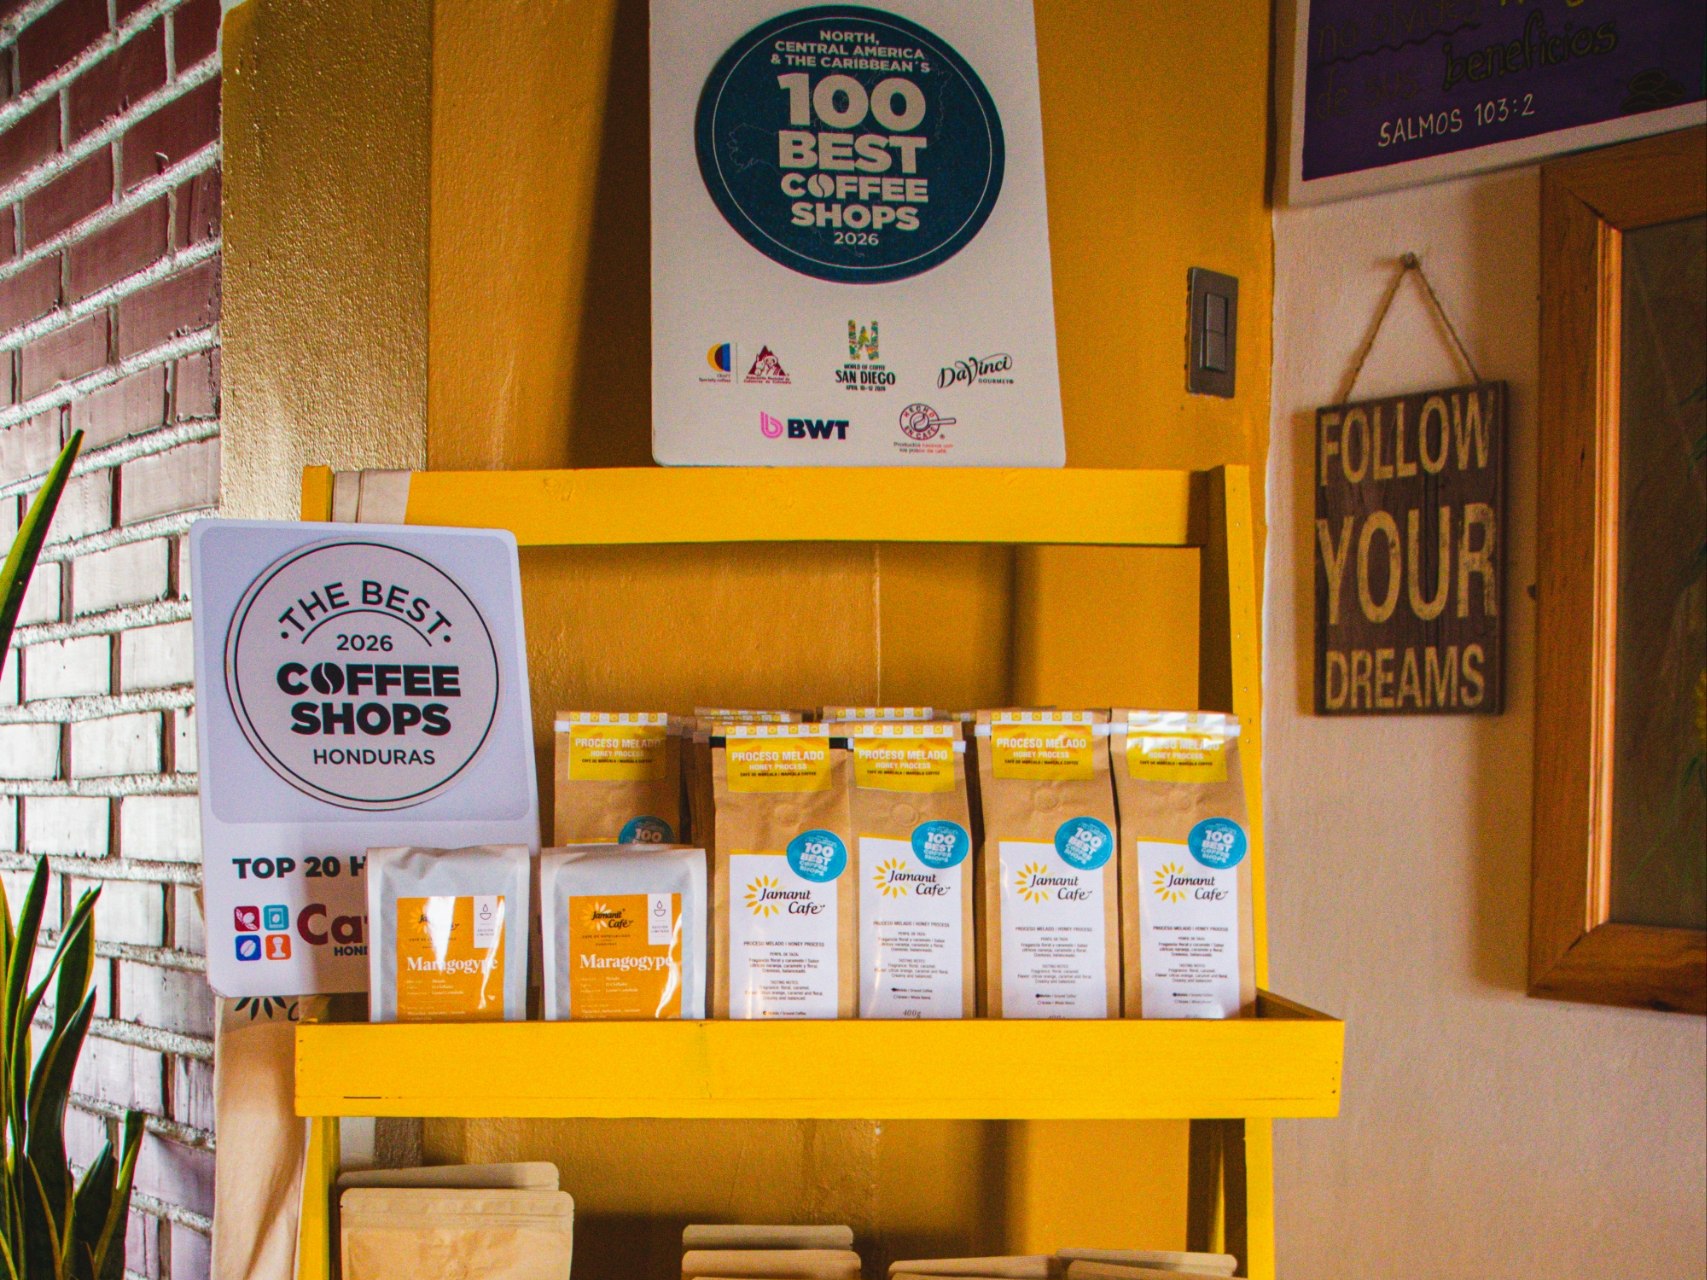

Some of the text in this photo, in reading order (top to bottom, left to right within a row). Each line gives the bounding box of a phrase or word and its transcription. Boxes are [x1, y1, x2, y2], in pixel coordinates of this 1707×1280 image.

[819, 30, 880, 46] NORTH,
[774, 40, 925, 60] CENTRAL AMERICA
[1442, 10, 1618, 90] beneficios
[770, 54, 781, 65] &
[784, 55, 817, 68] THE
[776, 72, 927, 132] 100
[1377, 93, 1535, 147] SALMOS 103:2
[778, 130, 928, 173] BEST
[780, 172, 929, 203] COFFEE
[790, 202, 920, 231] SHOPS
[833, 231, 879, 246] 2026
[835, 369, 896, 386] SAN DIEGO
[937, 353, 1013, 389] DaVinci
[787, 419, 849, 440] BWT
[1320, 390, 1494, 486] FOLLOW
[1316, 503, 1497, 625] YOUR
[336, 634, 393, 651] 2026
[276, 662, 461, 697] COFFEE
[1325, 643, 1486, 710] DREAMS
[290, 701, 452, 736] SHOPS
[575, 738, 619, 748] PROCESO
[996, 738, 1087, 748] PROCESO MELADO
[313, 749, 436, 765] HONDURAS
[732, 751, 825, 762] PROCESO MELADO
[858, 750, 948, 760] PROCESO MELADO
[635, 828, 662, 843] 100
[928, 832, 956, 845] 100
[1075, 827, 1102, 848] 100
[1205, 830, 1234, 845] 100
[805, 842, 834, 858] 100
[924, 842, 954, 852] BEST
[1068, 836, 1096, 855] BEST
[1201, 840, 1232, 853] BEST
[232, 857, 296, 879] TOP
[304, 856, 341, 878] 20
[800, 852, 832, 866] BEST
[580, 954, 674, 972] Maragogype
